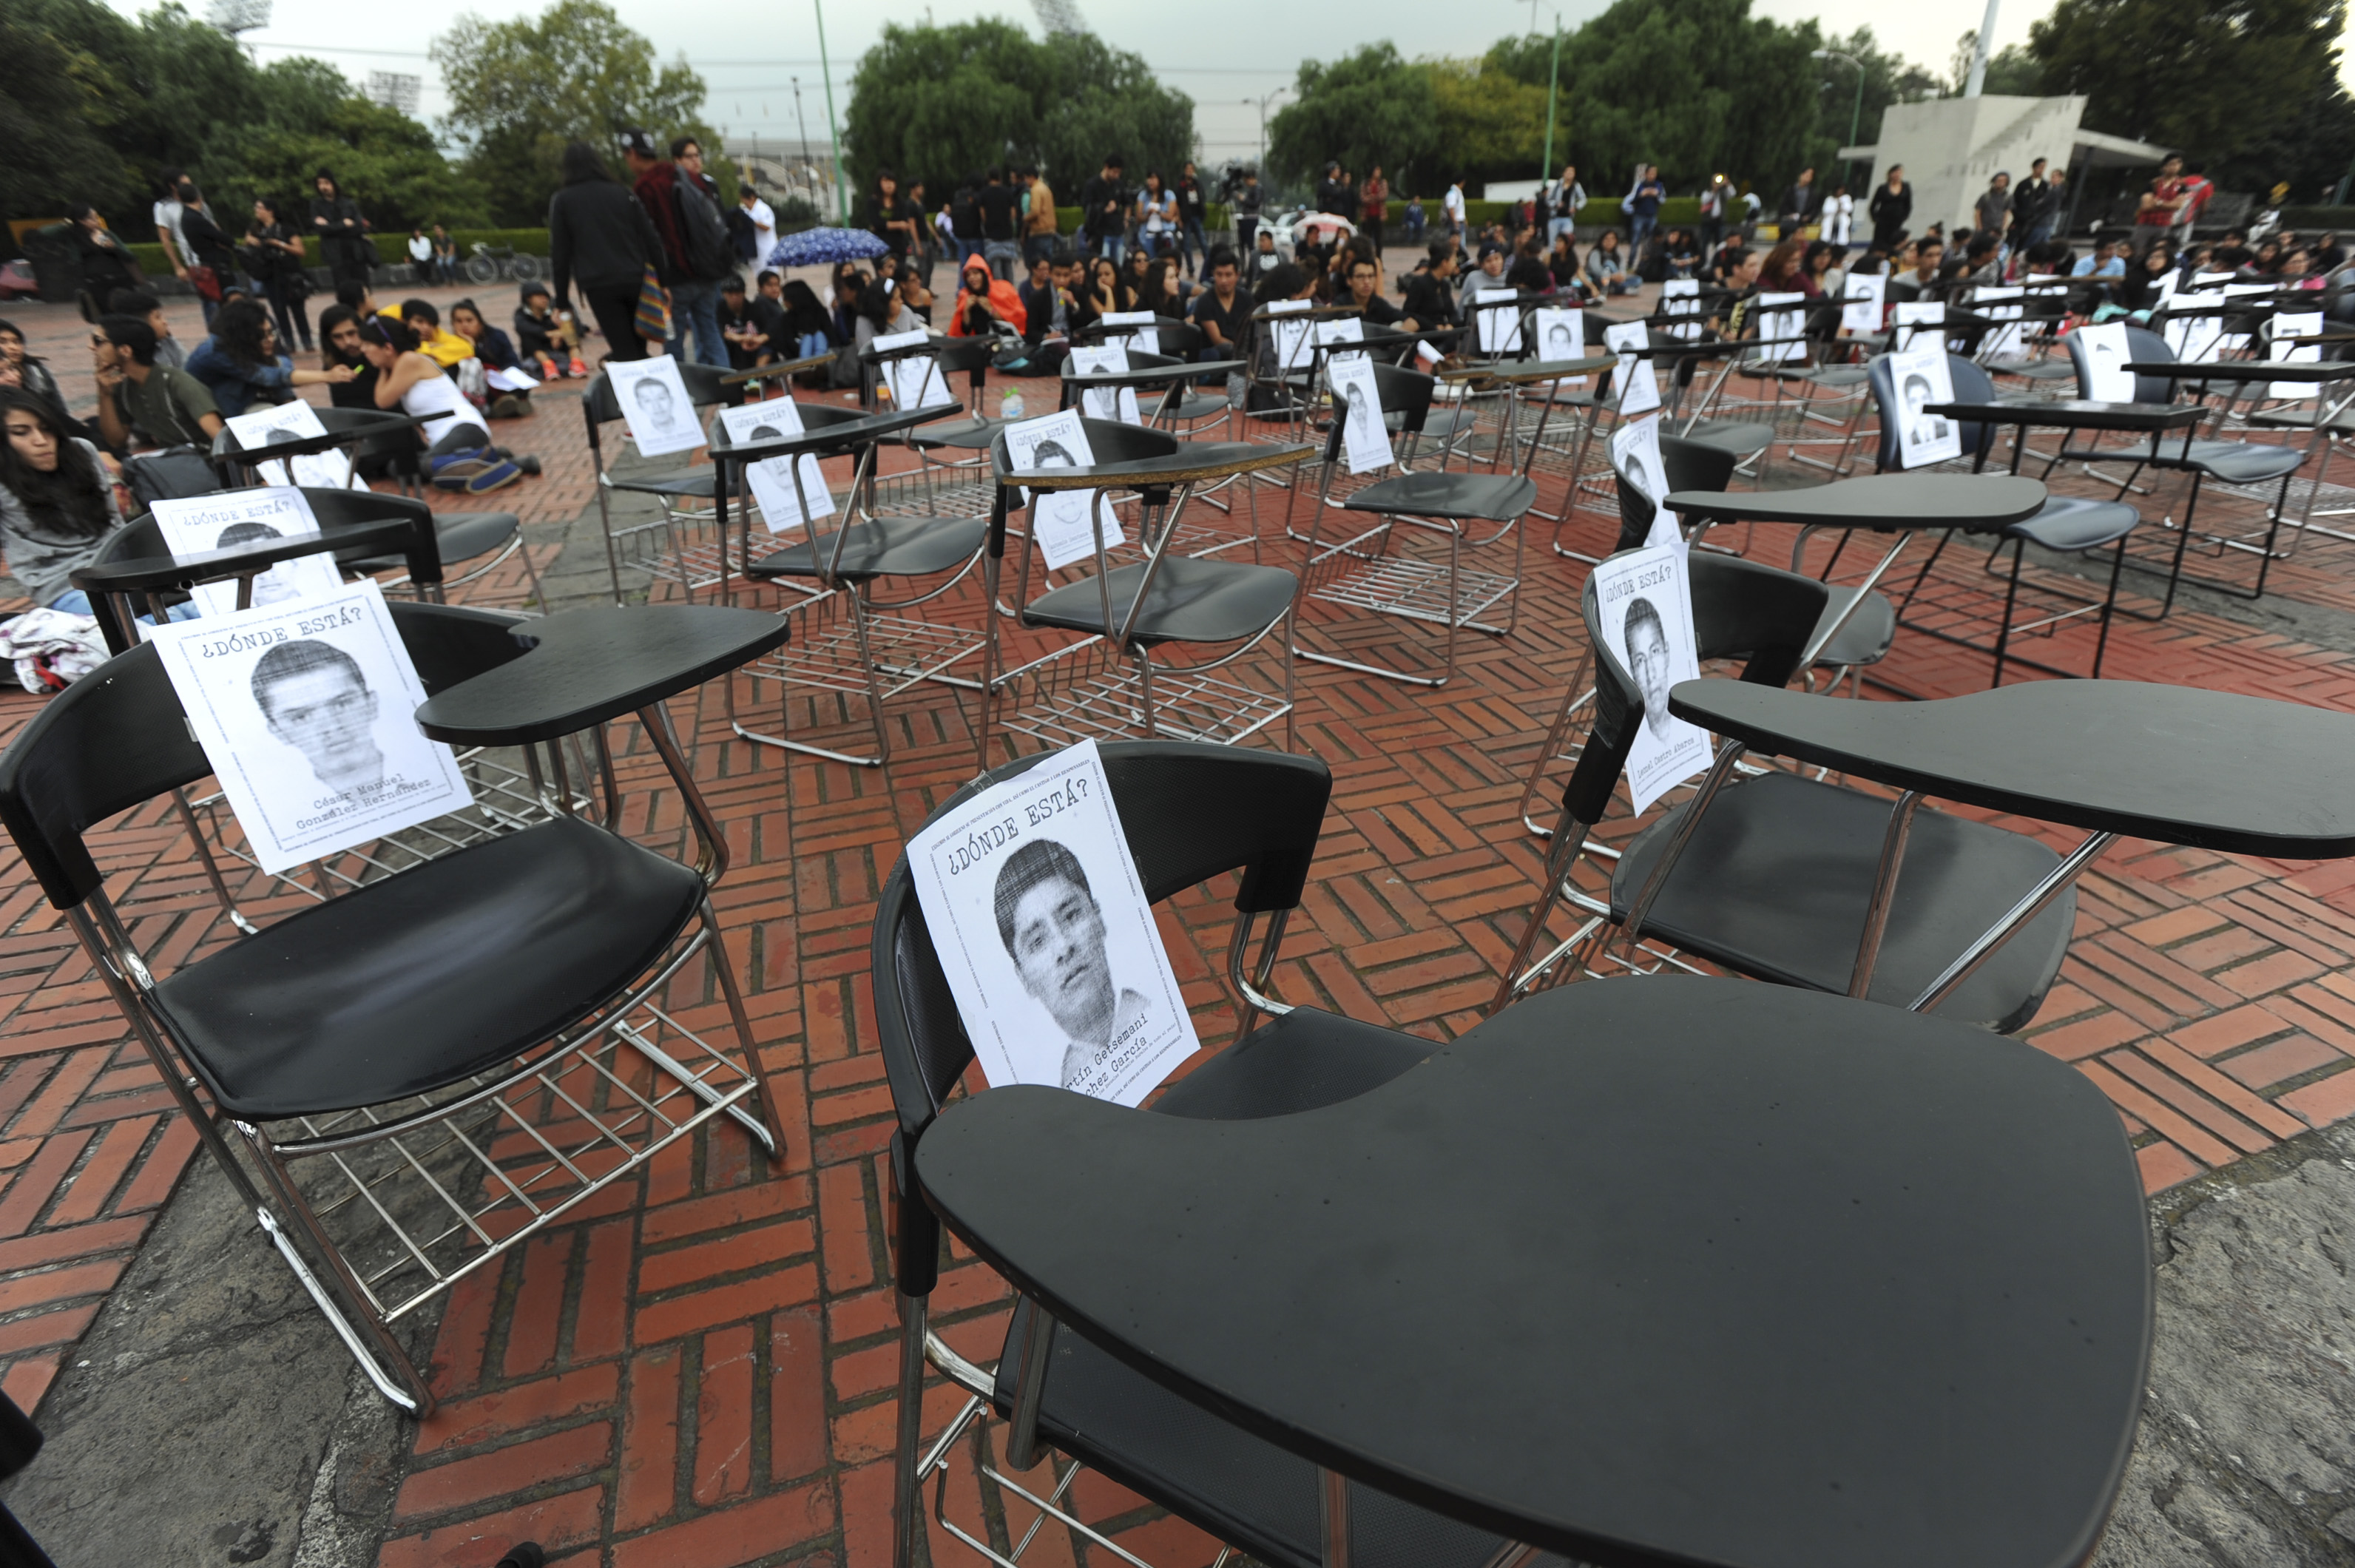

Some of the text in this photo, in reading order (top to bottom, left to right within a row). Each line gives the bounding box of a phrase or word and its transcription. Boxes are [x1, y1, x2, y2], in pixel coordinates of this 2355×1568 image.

[183, 500, 290, 526] ¿DÓNDE ESTÁ?
[1606, 579, 1635, 603] ¿DÓNDE
[1638, 564, 1672, 589] ESTÁ?
[203, 627, 288, 658] ¿DÓNDE
[297, 606, 362, 636] ESTÁ?
[1654, 749, 1672, 766] Castro
[1674, 737, 1695, 753] Abarca
[297, 803, 359, 830] González
[362, 779, 431, 807] Hernández
[314, 774, 405, 810] César Manuel
[949, 779, 1087, 875] ¿DÓNDE ESTÁ?
[1066, 1066, 1092, 1091] rtín
[1085, 1037, 1147, 1097] chez García
